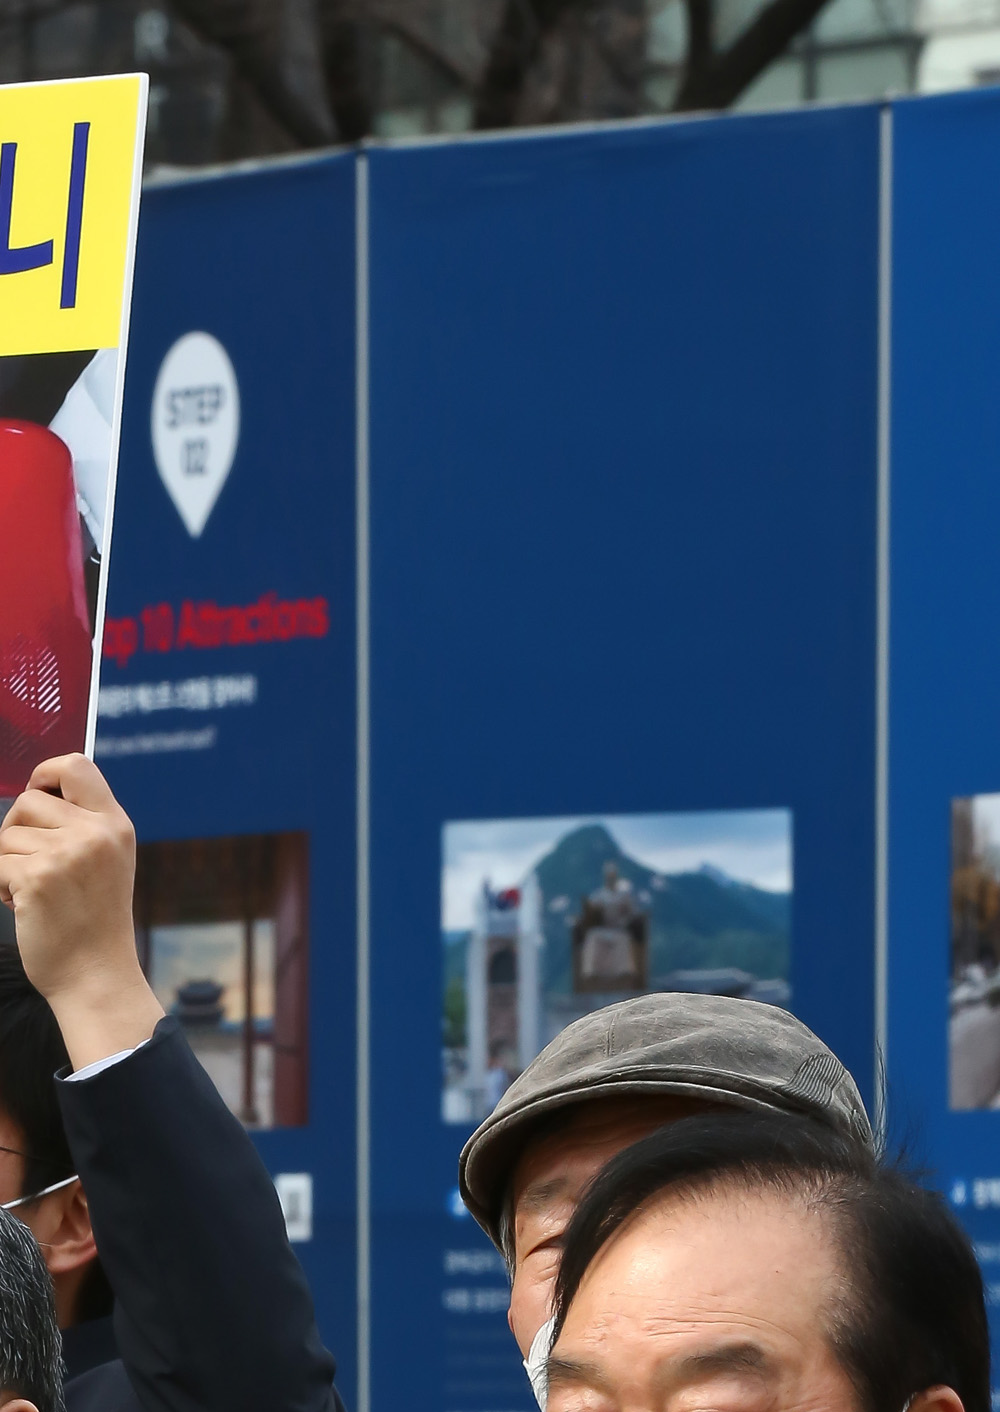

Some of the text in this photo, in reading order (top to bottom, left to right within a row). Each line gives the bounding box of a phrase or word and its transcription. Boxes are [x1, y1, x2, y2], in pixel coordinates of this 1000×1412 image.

[165, 384, 225, 428] STEP
[181, 439, 208, 475] 02
[103, 616, 138, 669] op
[177, 590, 330, 648] Attractions
